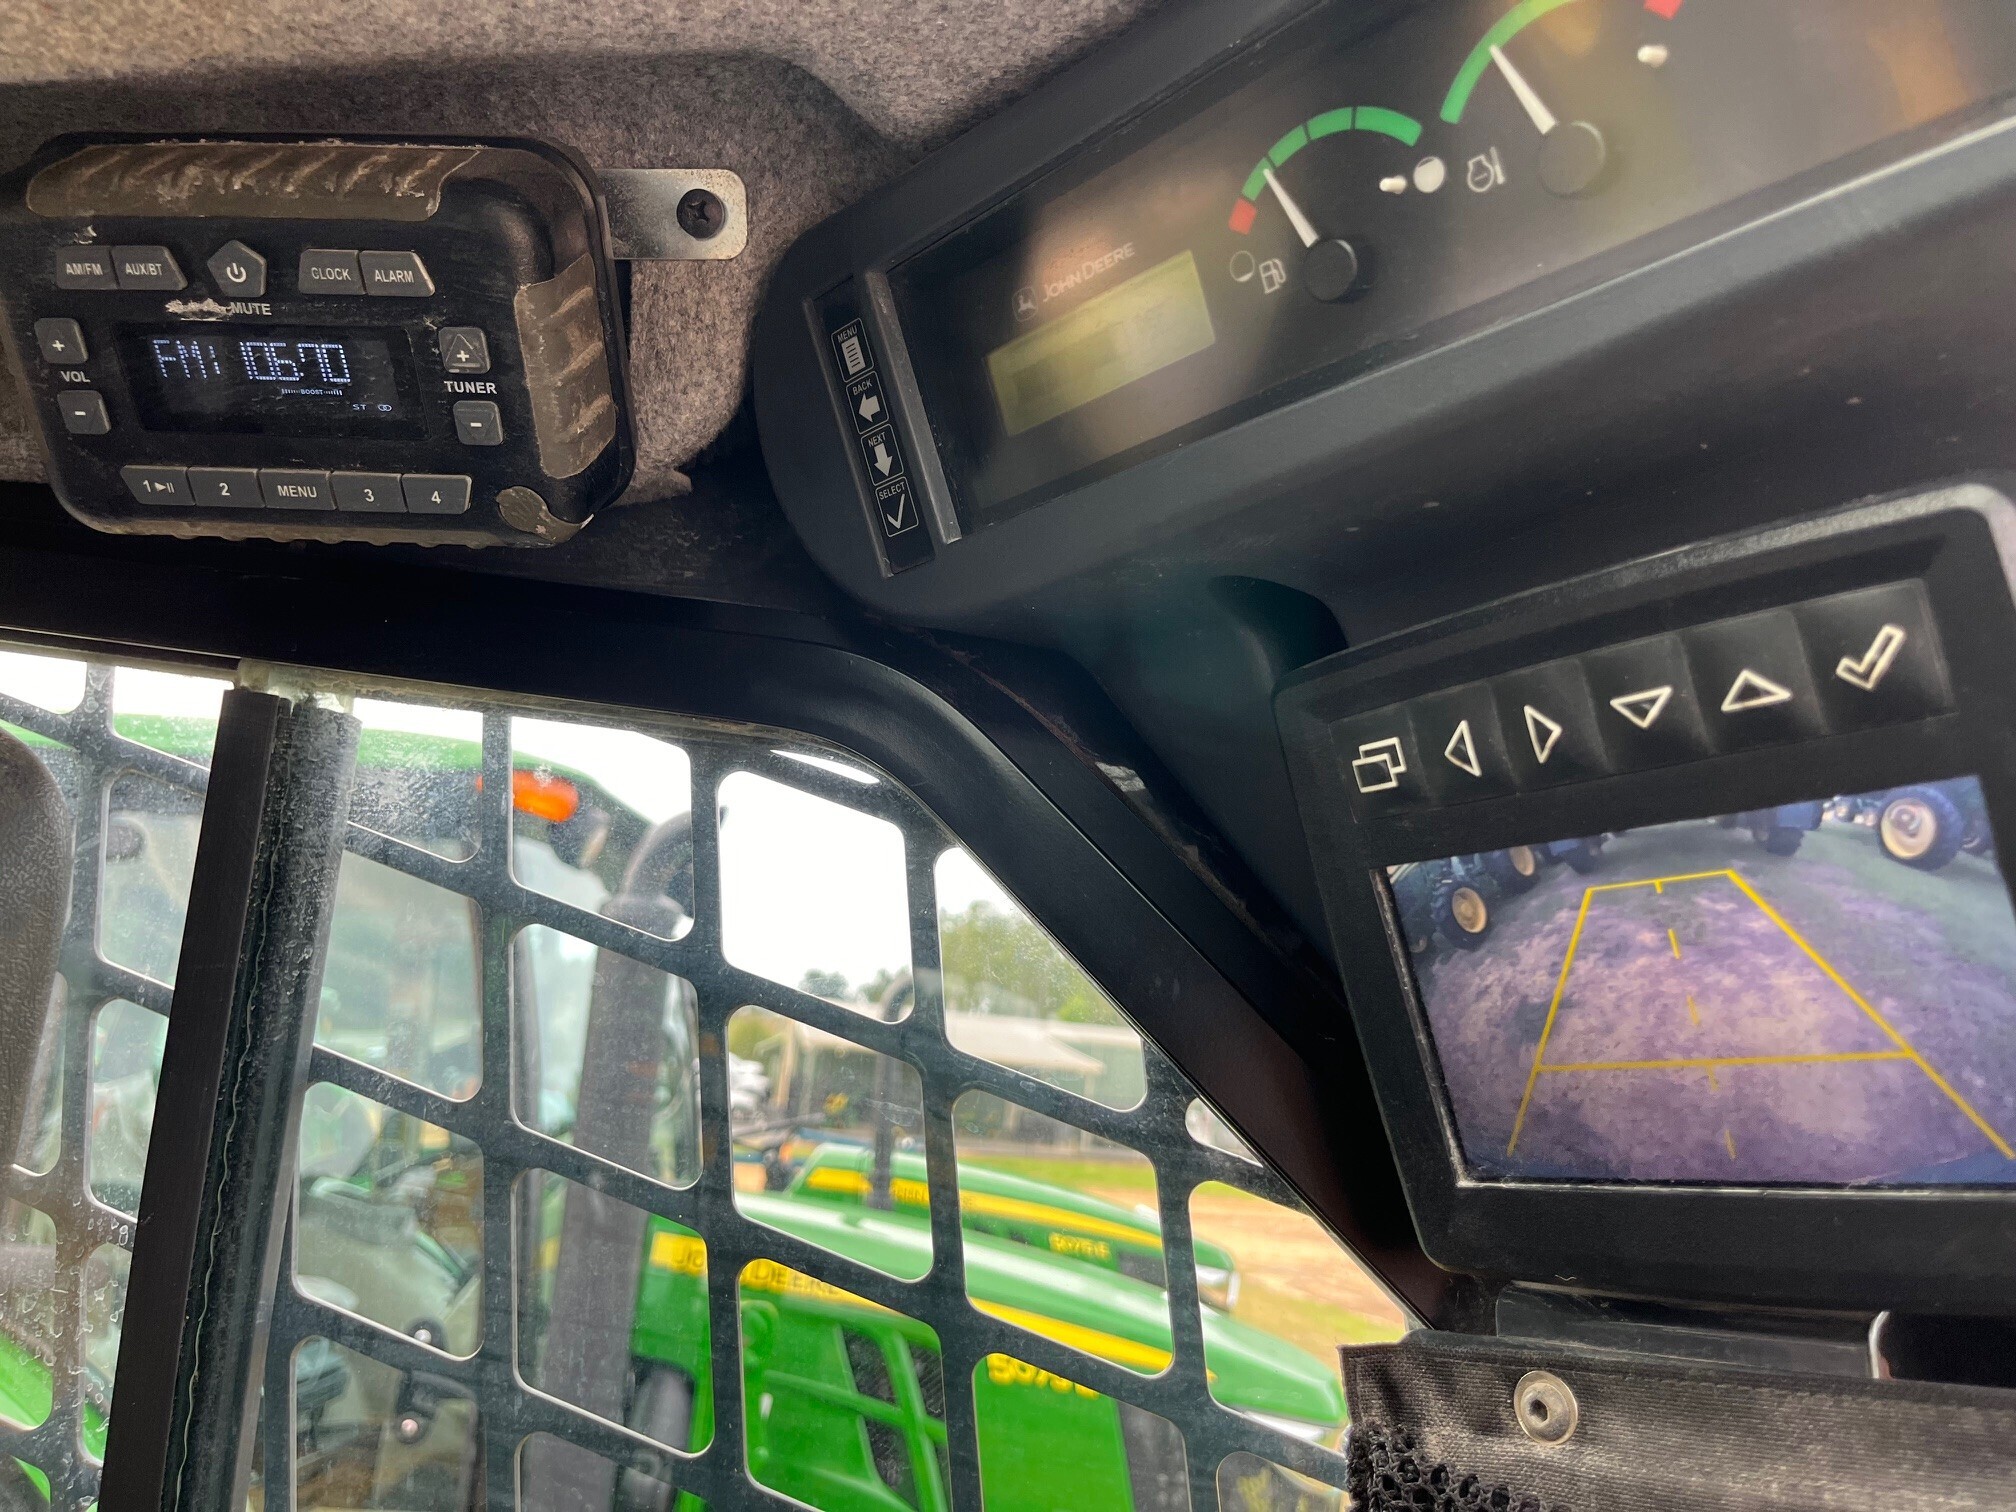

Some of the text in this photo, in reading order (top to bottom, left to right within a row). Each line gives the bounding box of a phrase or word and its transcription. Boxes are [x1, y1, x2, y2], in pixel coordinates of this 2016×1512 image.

[65, 263, 104, 276] AM/FM
[124, 262, 163, 276] AUX/BT
[310, 266, 352, 281] CLOCK
[374, 269, 415, 283] ALARM
[1042, 241, 1136, 303] JOHN DEERE
[229, 301, 272, 316] MUTE
[837, 324, 858, 343] MENU
[60, 370, 91, 383] VOL
[443, 380, 498, 395] TUNER
[852, 378, 873, 395] BACK
[868, 431, 887, 447] NEXT
[219, 483, 231, 497] 2
[277, 484, 318, 499] MENU
[364, 488, 375, 503] 3
[430, 490, 442, 504] 4
[878, 481, 906, 500] SELECT
